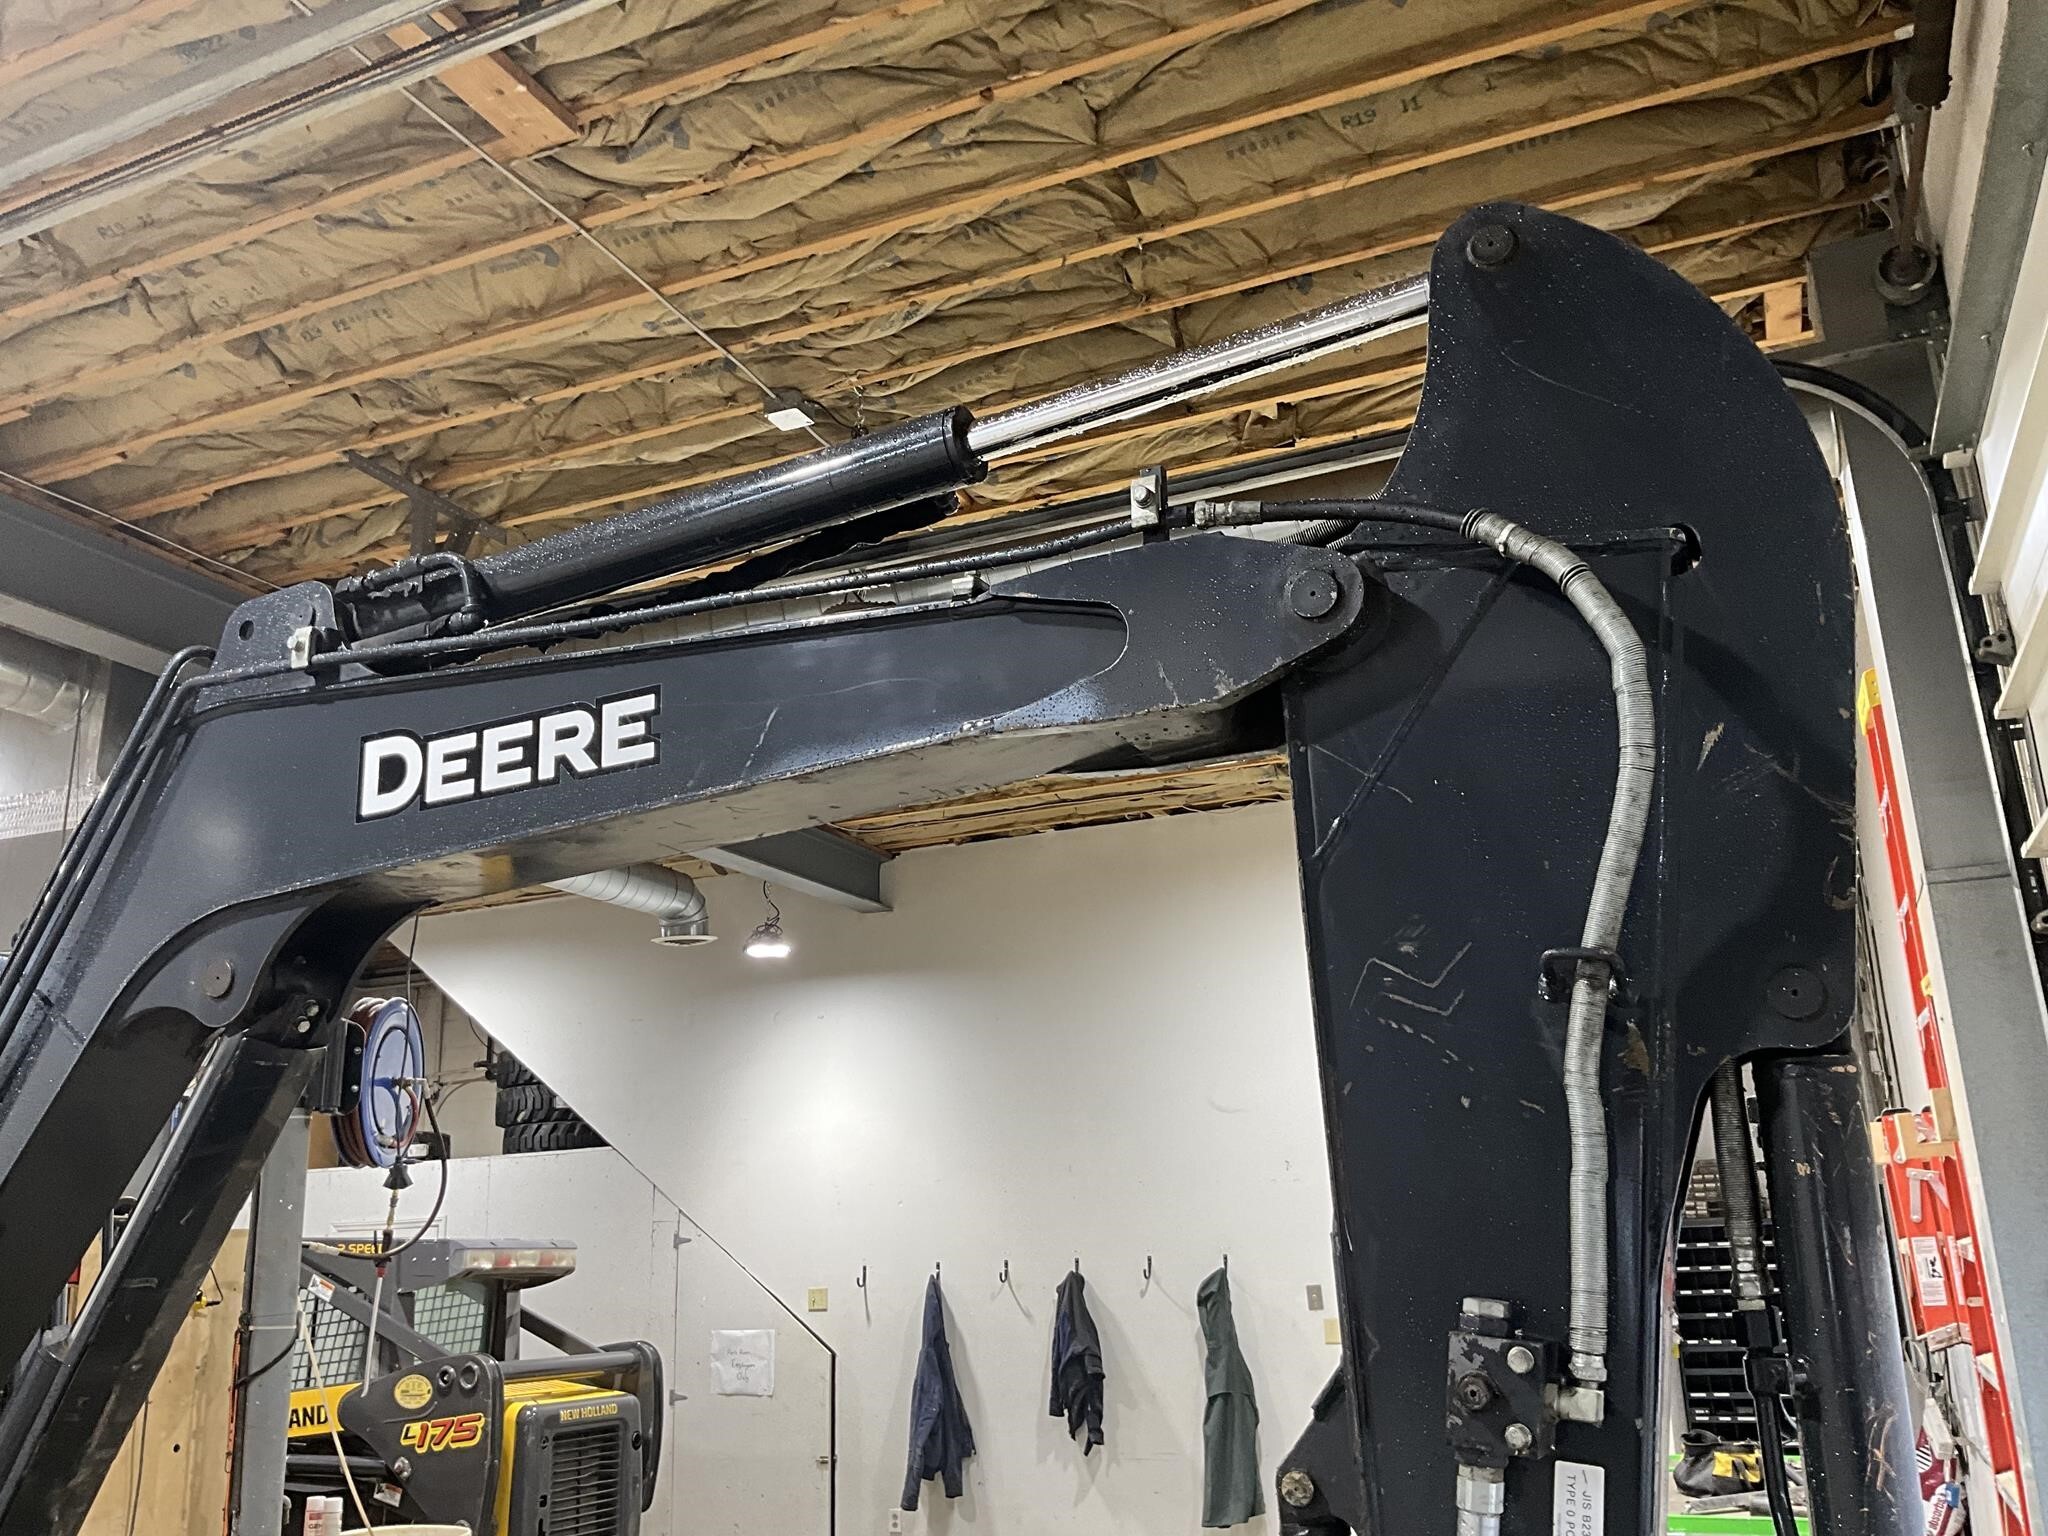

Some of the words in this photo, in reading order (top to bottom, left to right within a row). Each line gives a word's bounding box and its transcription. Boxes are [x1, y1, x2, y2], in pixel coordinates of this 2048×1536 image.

[1341, 108, 1377, 129] R19
[360, 693, 656, 817] DEERE
[560, 1408, 580, 1422] NEW
[581, 1403, 618, 1419] HOLLAND
[402, 1414, 483, 1450] L175
[1566, 1474, 1576, 1507] TYPE
[1582, 1490, 1592, 1510] JIS
